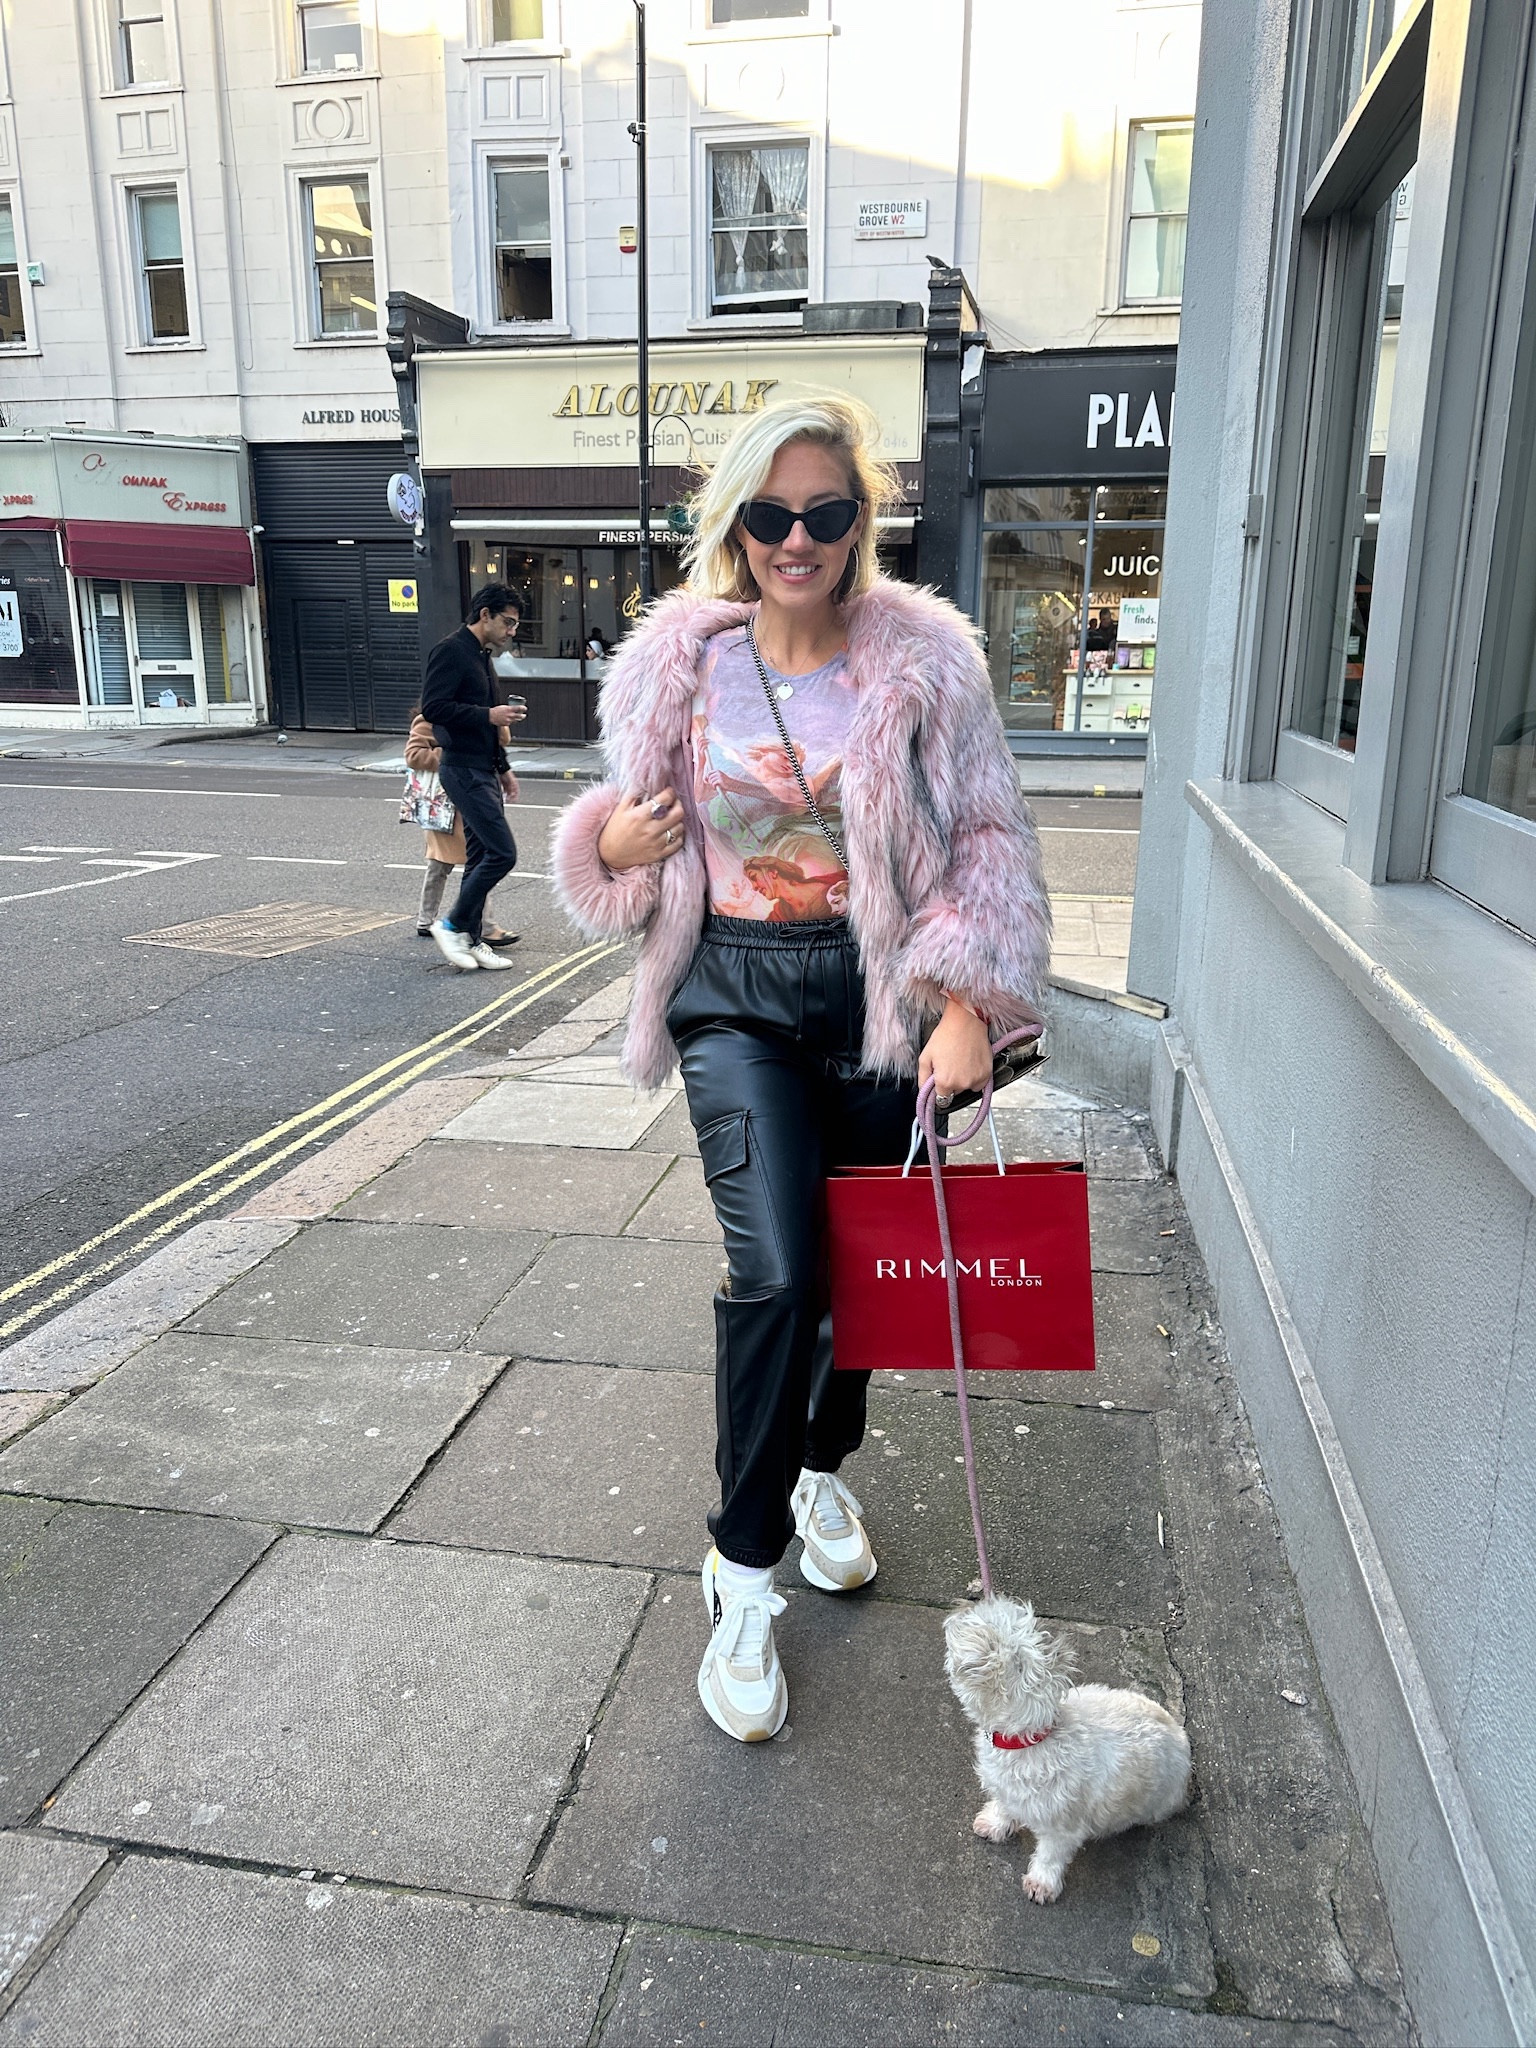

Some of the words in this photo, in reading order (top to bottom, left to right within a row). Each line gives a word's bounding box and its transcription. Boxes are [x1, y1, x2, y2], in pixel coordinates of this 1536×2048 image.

[860, 202, 922, 214] WESTBOURNE
[859, 215, 888, 226] GROVE
[891, 214, 905, 225] W2
[552, 379, 779, 417] ALOUNAK
[302, 410, 355, 424] ALFRED
[573, 430, 620, 447] Finest
[906, 480, 919, 491] 44
[599, 531, 643, 542] FINEST
[1103, 555, 1160, 577] JUIC
[1123, 604, 1145, 615] Fresh
[1134, 615, 1157, 625] finds.
[876, 1258, 1042, 1279] RIMMEL
[990, 1279, 1043, 1287] LONDON
